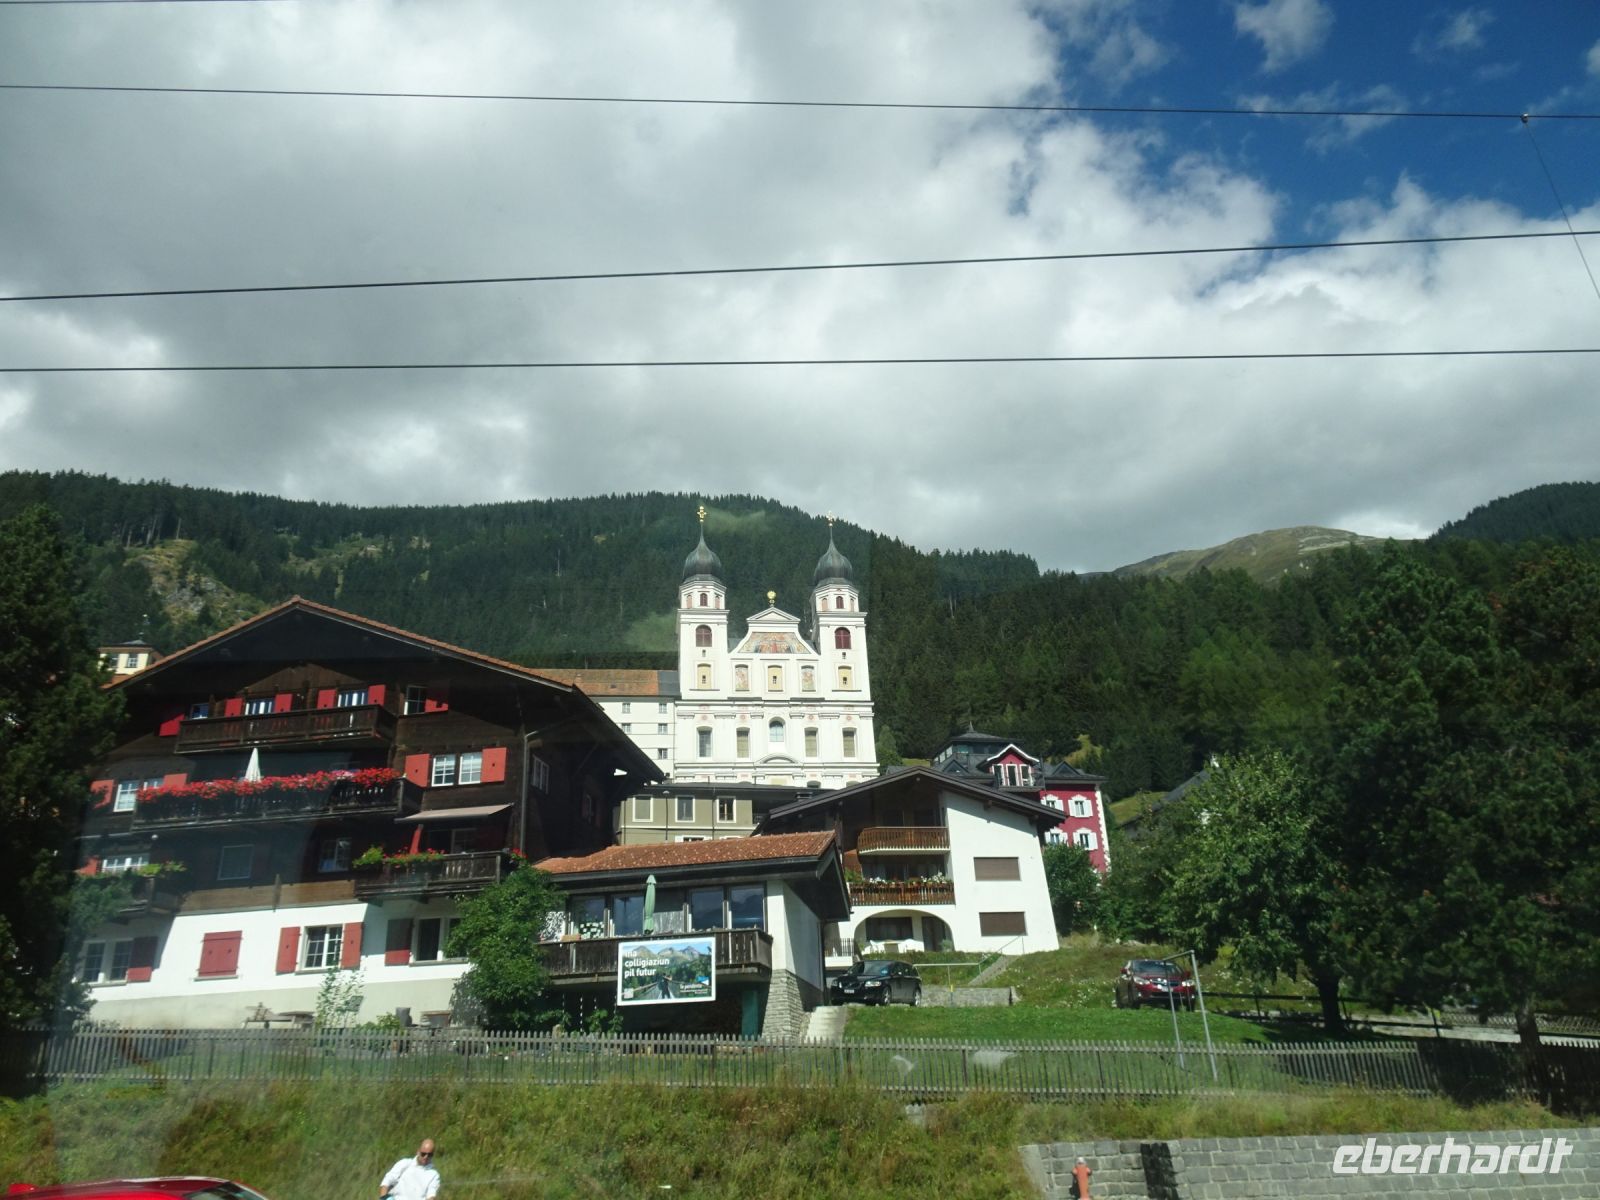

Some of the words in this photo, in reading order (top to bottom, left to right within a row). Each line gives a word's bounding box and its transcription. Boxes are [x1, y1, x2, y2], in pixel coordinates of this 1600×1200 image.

[624, 958, 670, 968] colligiaziun
[624, 968, 635, 979] pil
[636, 967, 657, 977] futur
